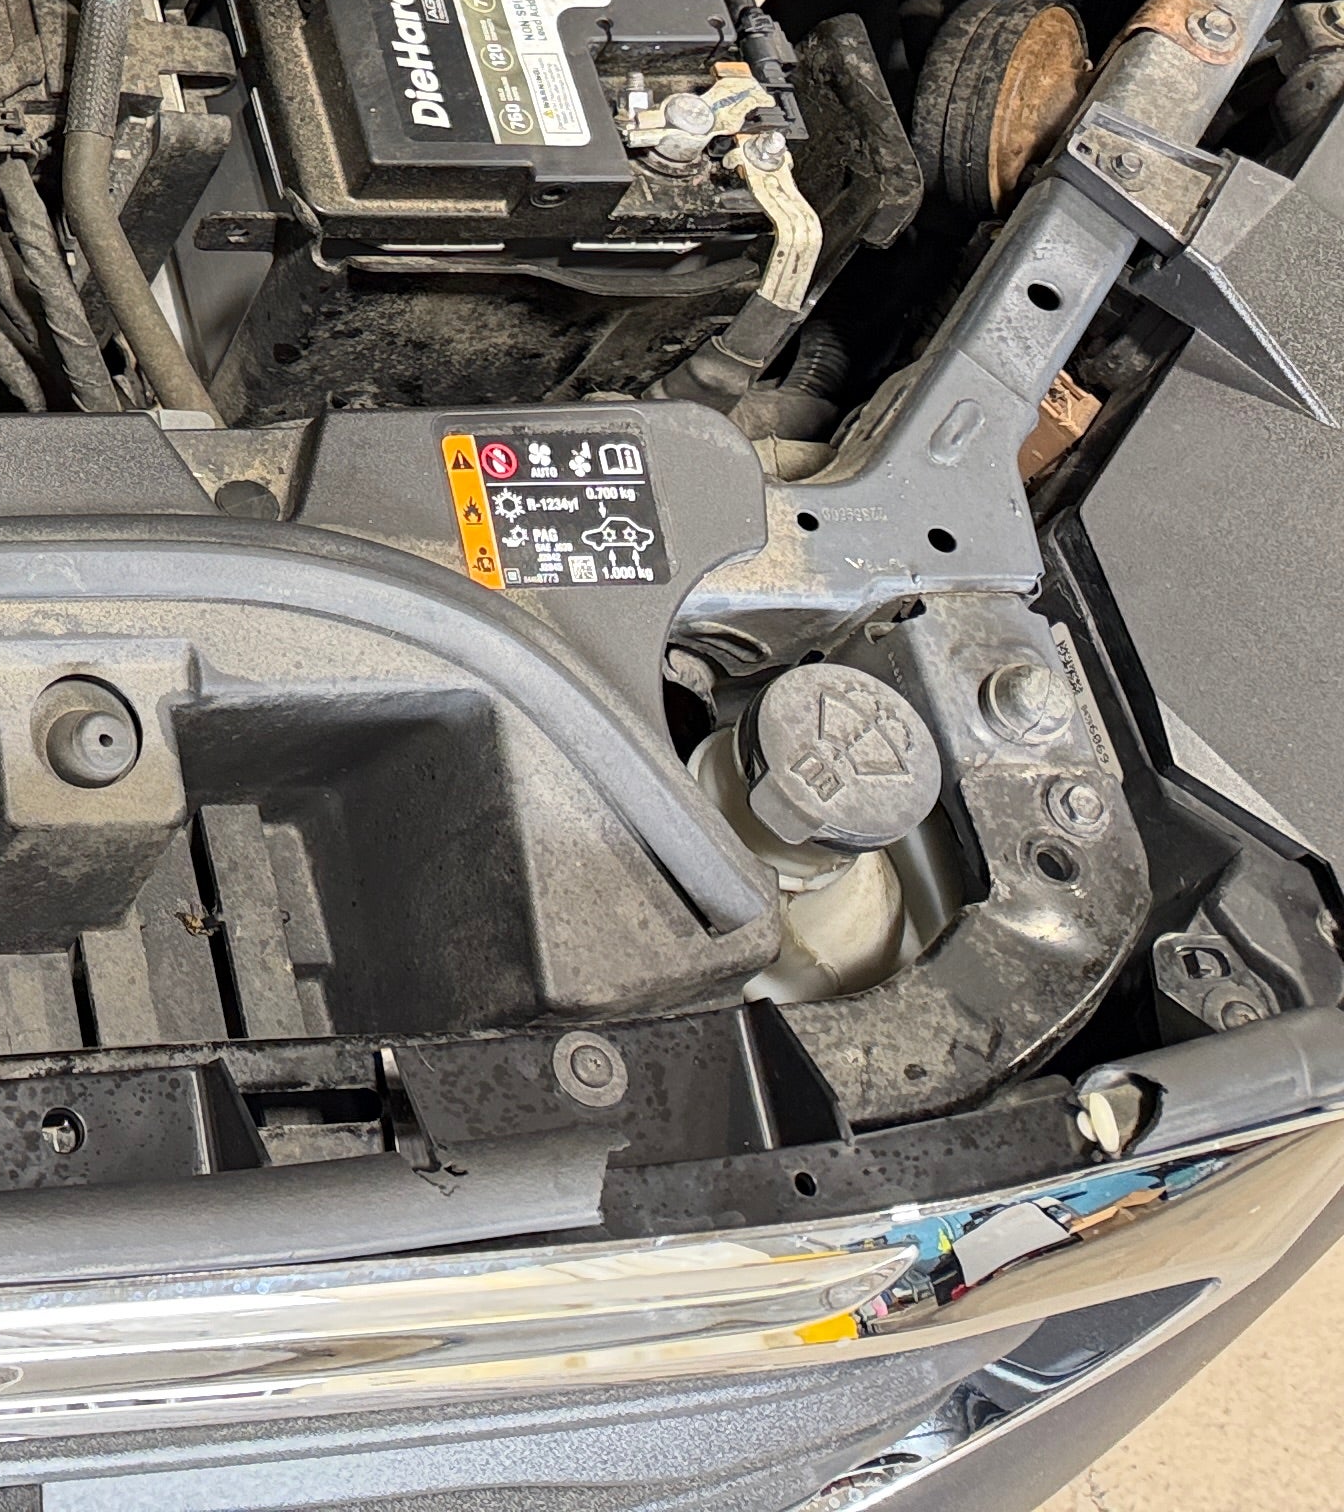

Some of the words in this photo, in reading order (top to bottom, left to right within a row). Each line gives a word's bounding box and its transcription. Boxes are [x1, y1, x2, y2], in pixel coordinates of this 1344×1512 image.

[533, 19, 548, 42] Lead
[485, 43, 508, 68] 120
[503, 103, 527, 131] 760
[530, 466, 559, 479] AUTO
[585, 486, 620, 501] 0.700
[620, 486, 637, 503] kg
[525, 497, 581, 513] R-1234yf
[531, 527, 560, 543] PAG
[534, 542, 553, 553] SAE
[601, 567, 637, 581] 1.000
[637, 566, 655, 582] kg
